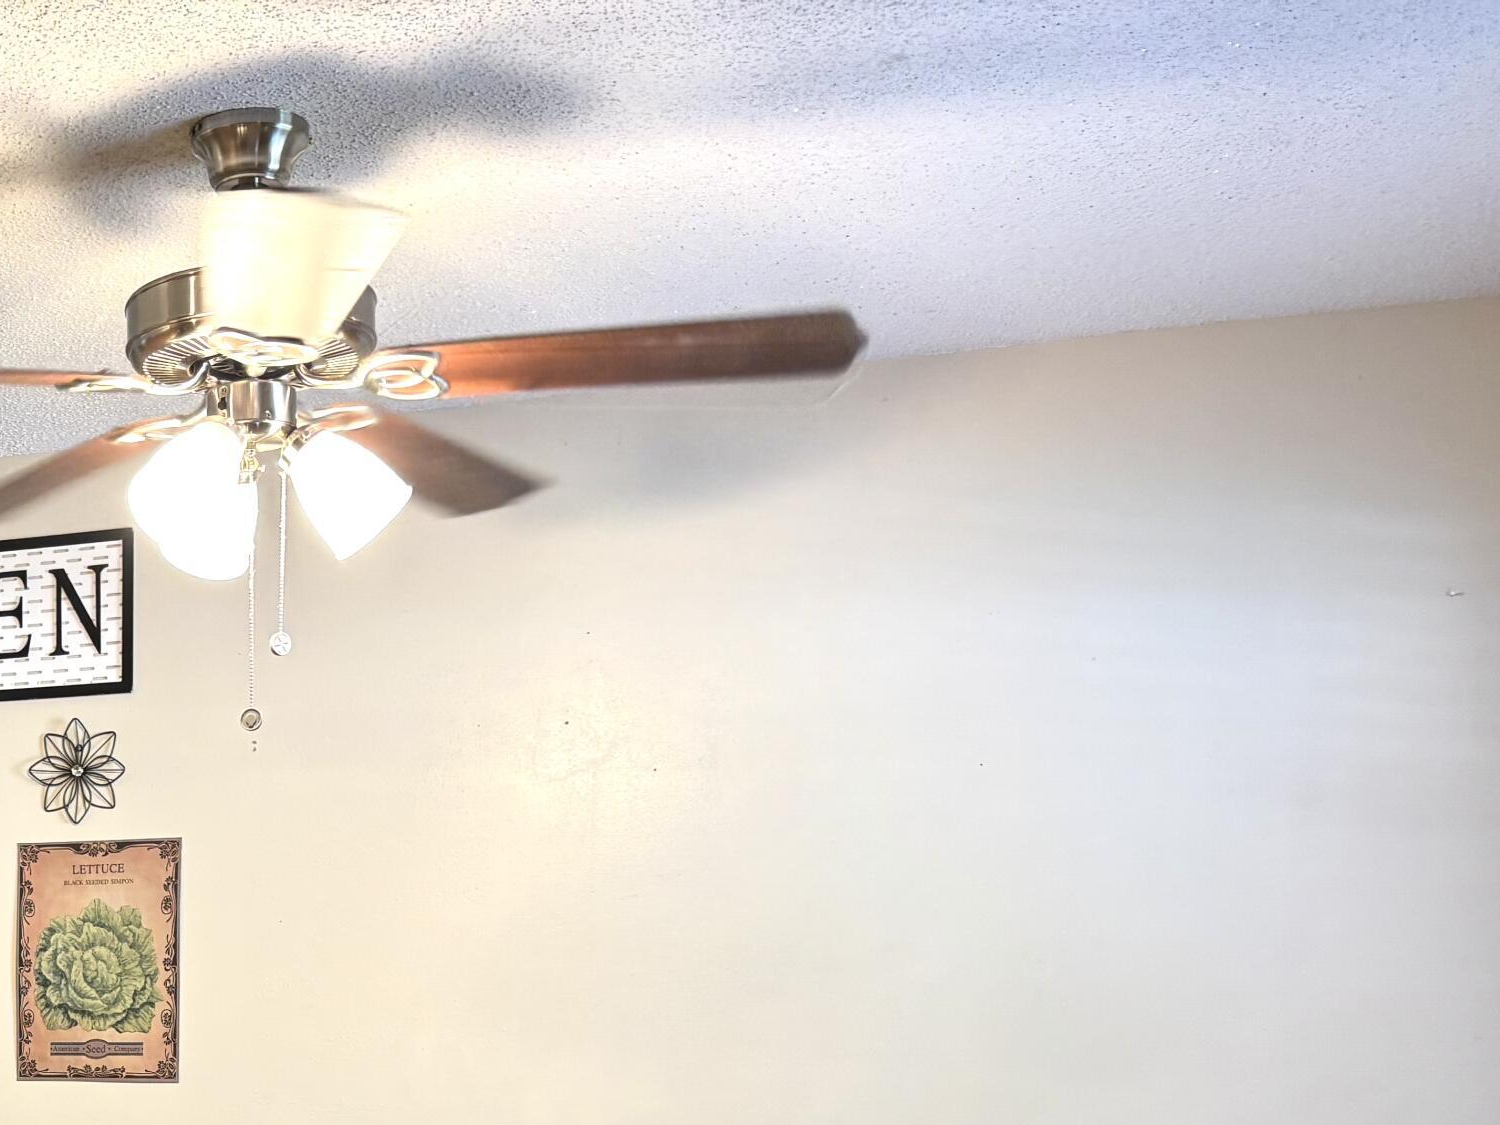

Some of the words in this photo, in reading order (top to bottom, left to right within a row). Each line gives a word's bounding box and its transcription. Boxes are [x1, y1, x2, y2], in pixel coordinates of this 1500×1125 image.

[72, 863, 125, 875] LETTUCE
[85, 1044, 106, 1054] Seed
[114, 1045, 141, 1053] Company
